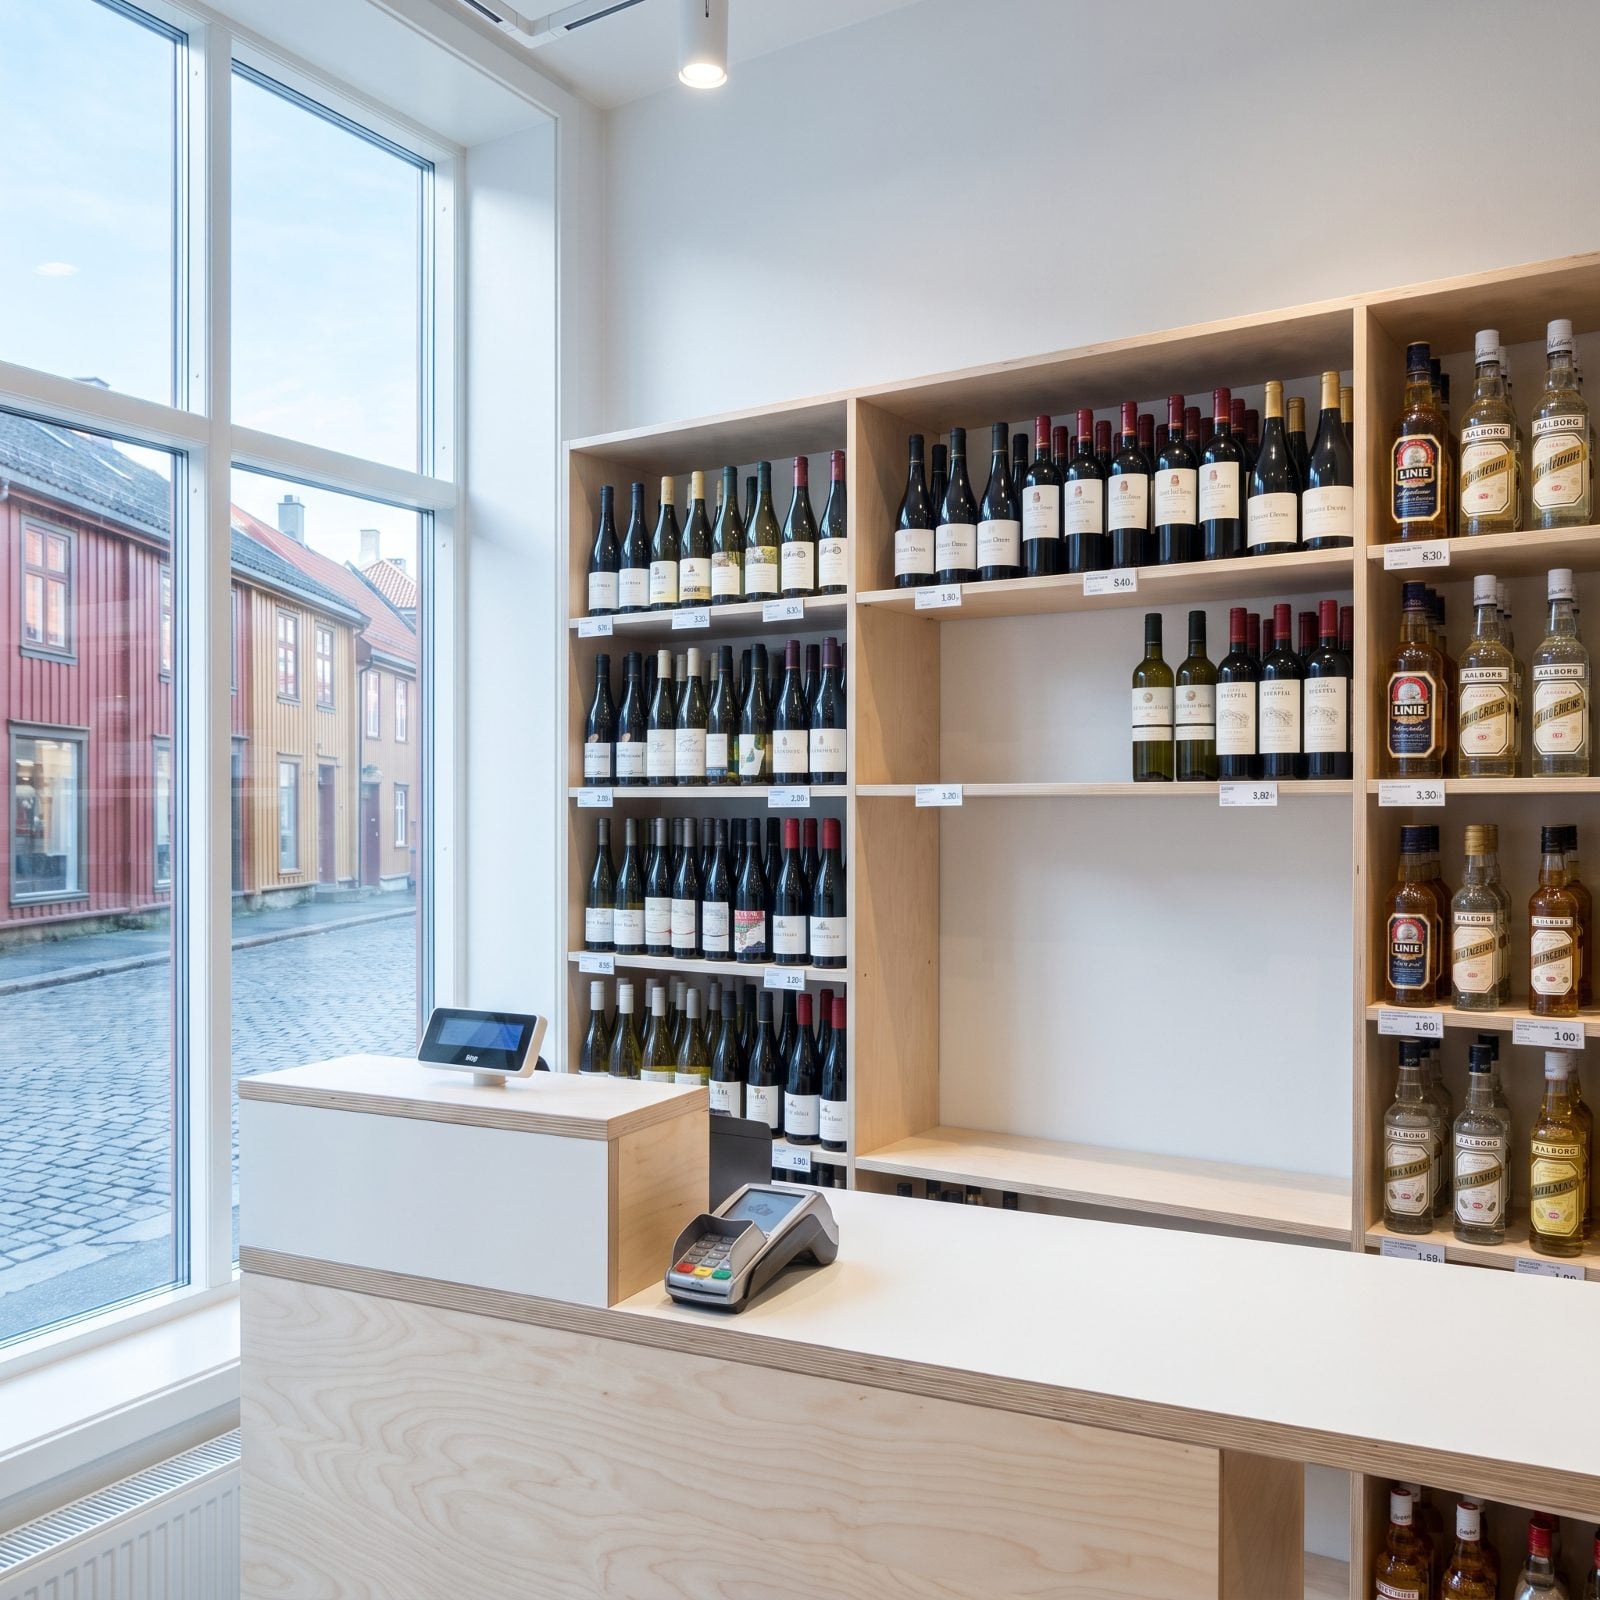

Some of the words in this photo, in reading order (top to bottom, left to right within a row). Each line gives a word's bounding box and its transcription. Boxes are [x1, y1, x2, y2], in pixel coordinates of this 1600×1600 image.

[1536, 418, 1579, 431] AALBORG
[1465, 427, 1506, 438] AALBORG
[1399, 467, 1429, 480] LINIE
[1394, 705, 1425, 716] LINIE
[1394, 944, 1420, 953] LINIE
[1535, 1145, 1576, 1155] AALBORG
